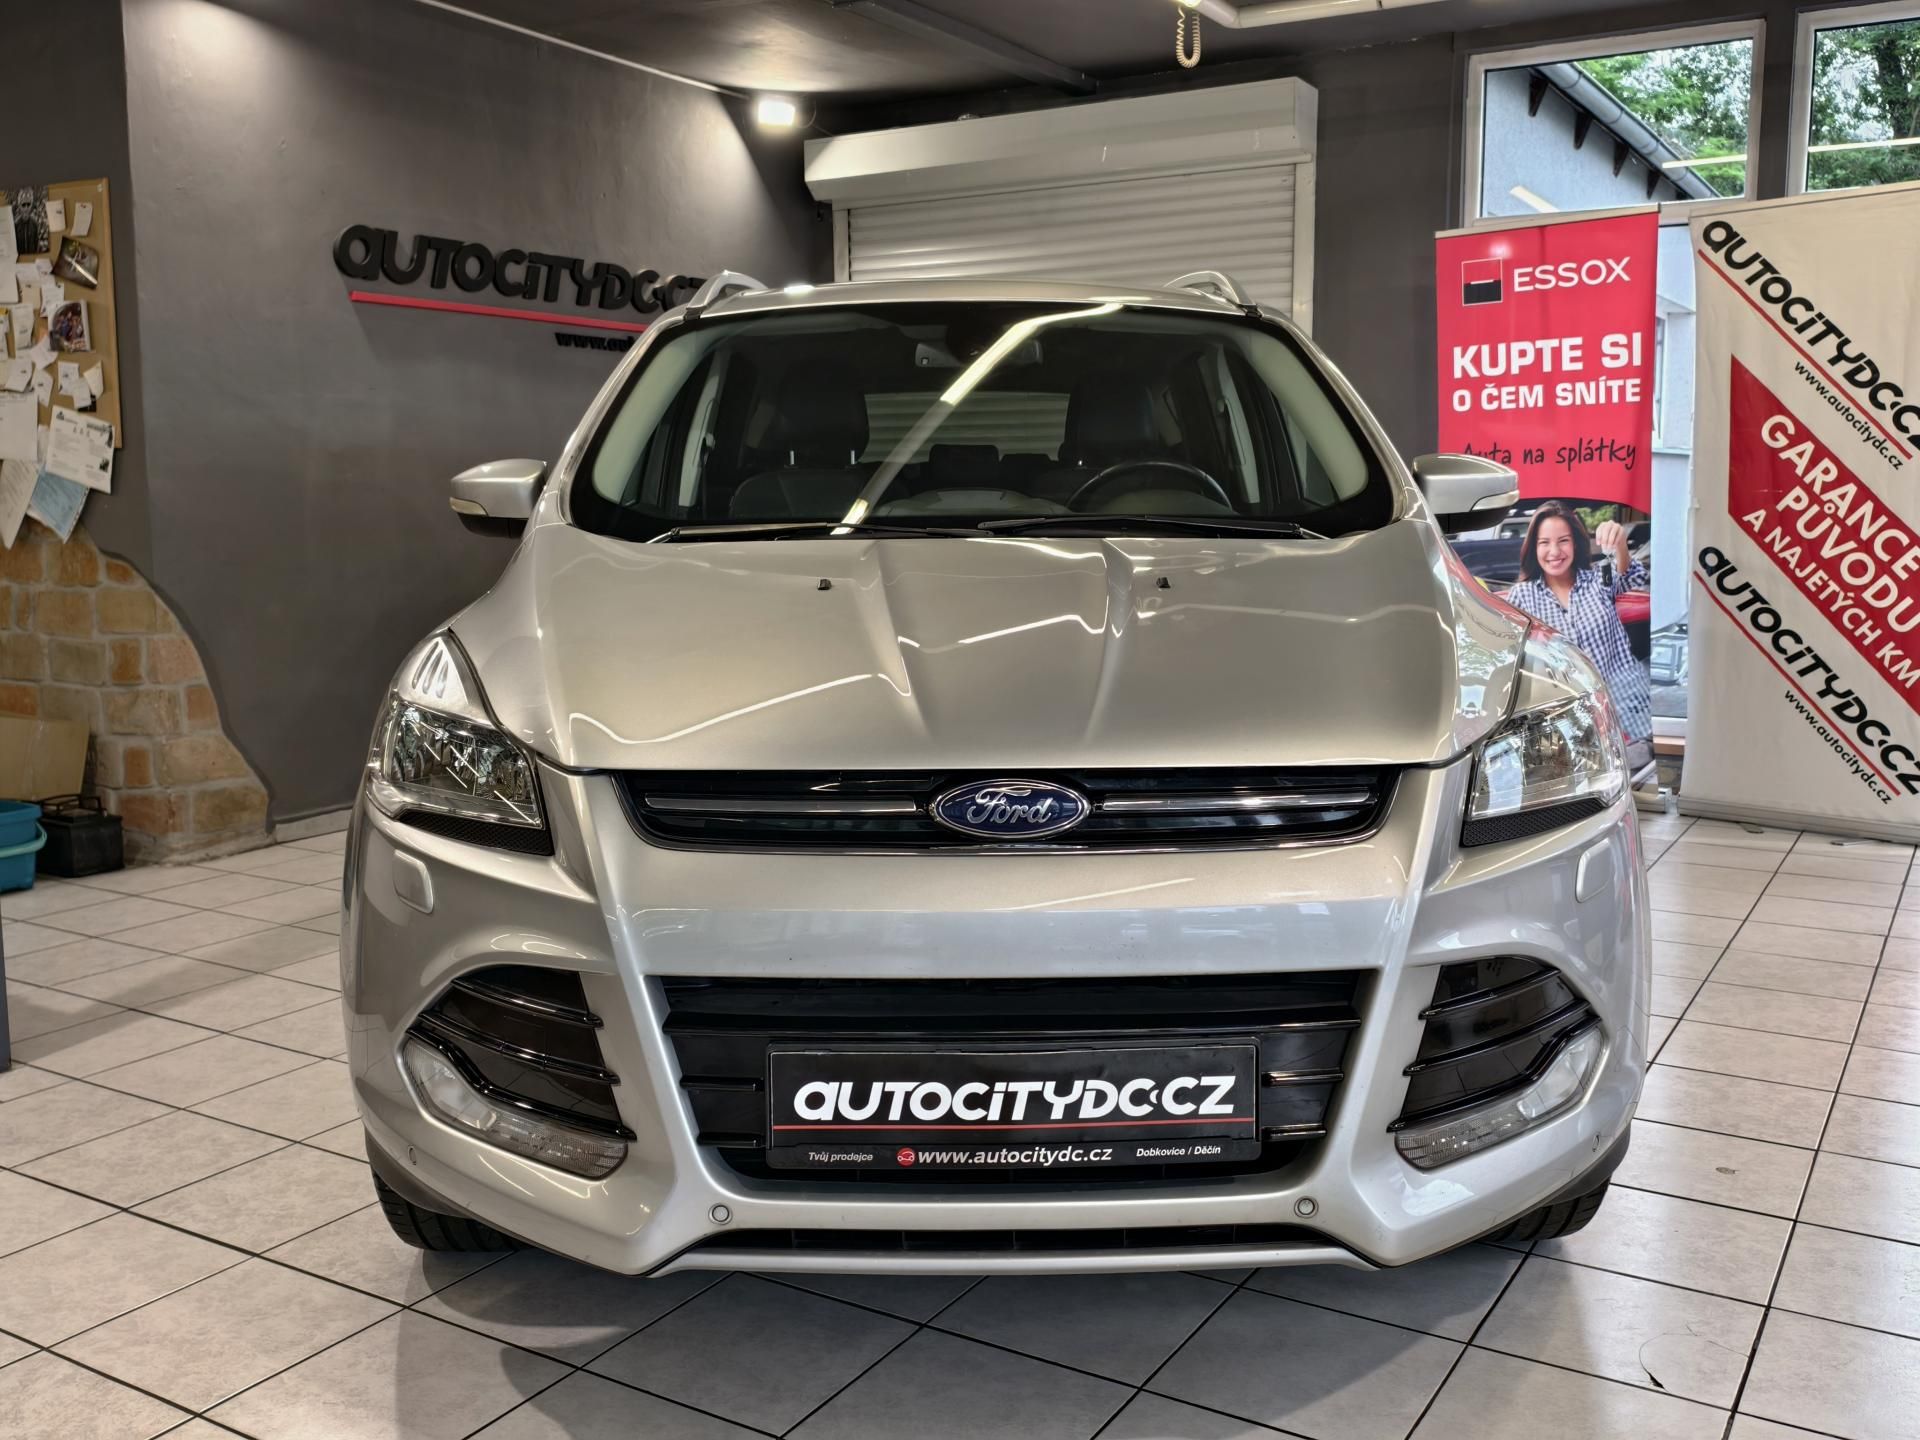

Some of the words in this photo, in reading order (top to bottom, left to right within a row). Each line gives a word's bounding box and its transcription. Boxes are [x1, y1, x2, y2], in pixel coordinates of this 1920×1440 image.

[1513, 256, 1632, 292] ESSOX
[1453, 336, 1584, 379] KUPTE
[1600, 331, 1643, 369] SI
[1452, 388, 1472, 412] O
[1480, 383, 1544, 411] ČEM
[1555, 376, 1641, 407] SNÍTE
[1794, 361, 1904, 471] www.autocitydc.cz
[1523, 448, 1545, 465] na
[1555, 437, 1637, 472] splátky
[1760, 414, 1920, 582] GARANCE
[1775, 485, 1920, 633] PŮVODU
[1742, 508, 1767, 533] A
[1763, 525, 1883, 647] NAJETÝCH
[1874, 641, 1920, 688] KM
[1784, 689, 1893, 805] www.autocitydc.cz
[966, 787, 1054, 824] Ford
[808, 1151, 829, 1163] Tvůj
[830, 1152, 874, 1163] prodejce
[917, 1146, 1113, 1168] www.autocitydc.cz
[1135, 1147, 1186, 1158] Dobkovice
[1194, 1145, 1222, 1156] Děčín
